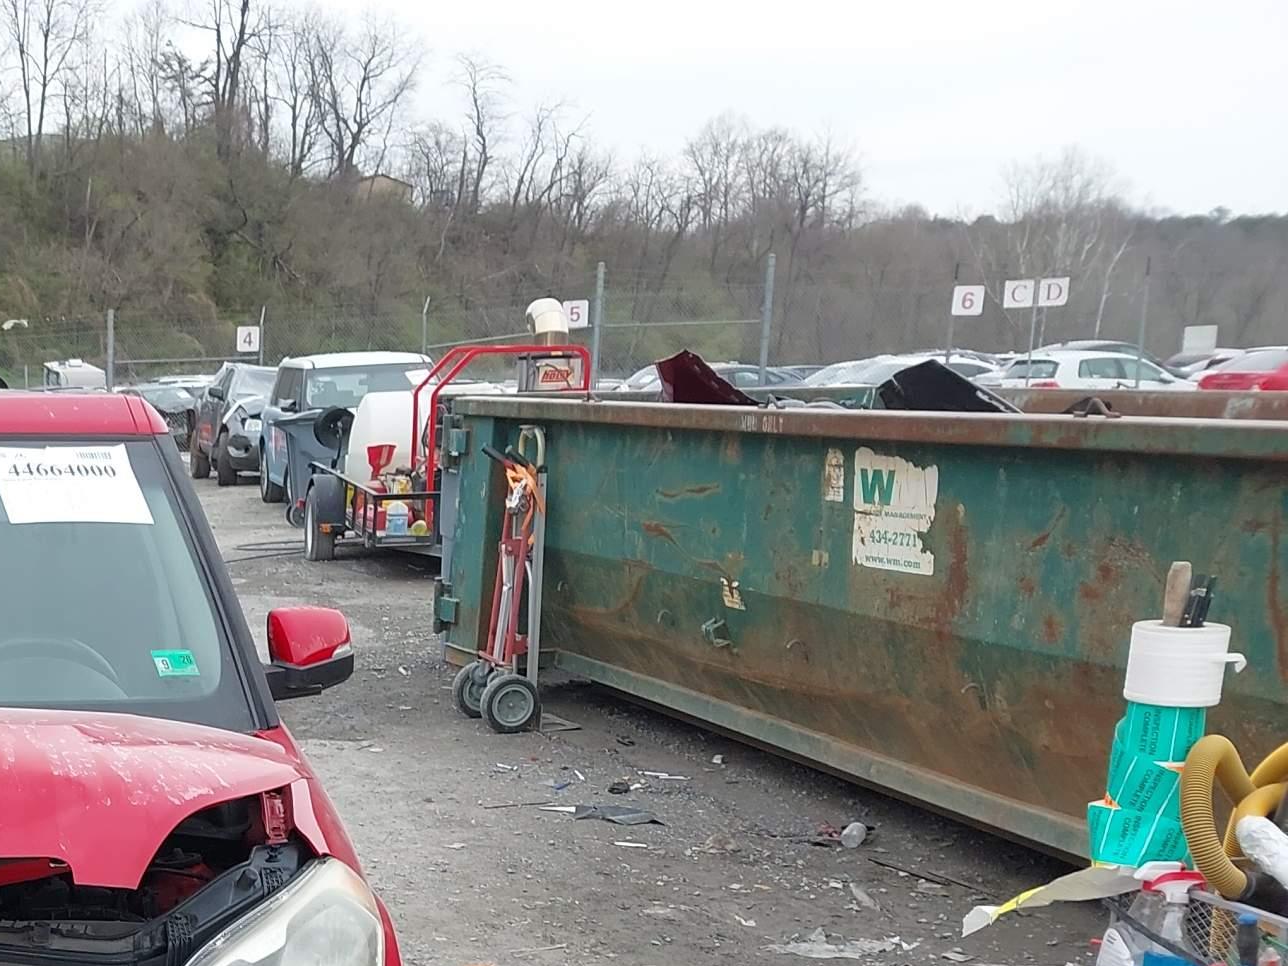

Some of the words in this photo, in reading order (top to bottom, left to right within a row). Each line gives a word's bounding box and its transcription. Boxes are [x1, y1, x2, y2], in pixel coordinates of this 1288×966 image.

[961, 291, 974, 310] 6
[1011, 284, 1027, 303] C
[1046, 282, 1063, 301] D
[569, 306, 581, 322] 5
[243, 331, 254, 347] 4
[8, 462, 117, 478] 44664000
[870, 529, 917, 548] 434-2771
[864, 554, 921, 569] www.wm.com
[1139, 711, 1152, 752] COMPLETE
[1129, 768, 1154, 809] COMPLETE
[1137, 769, 1167, 813] INSPECTION
